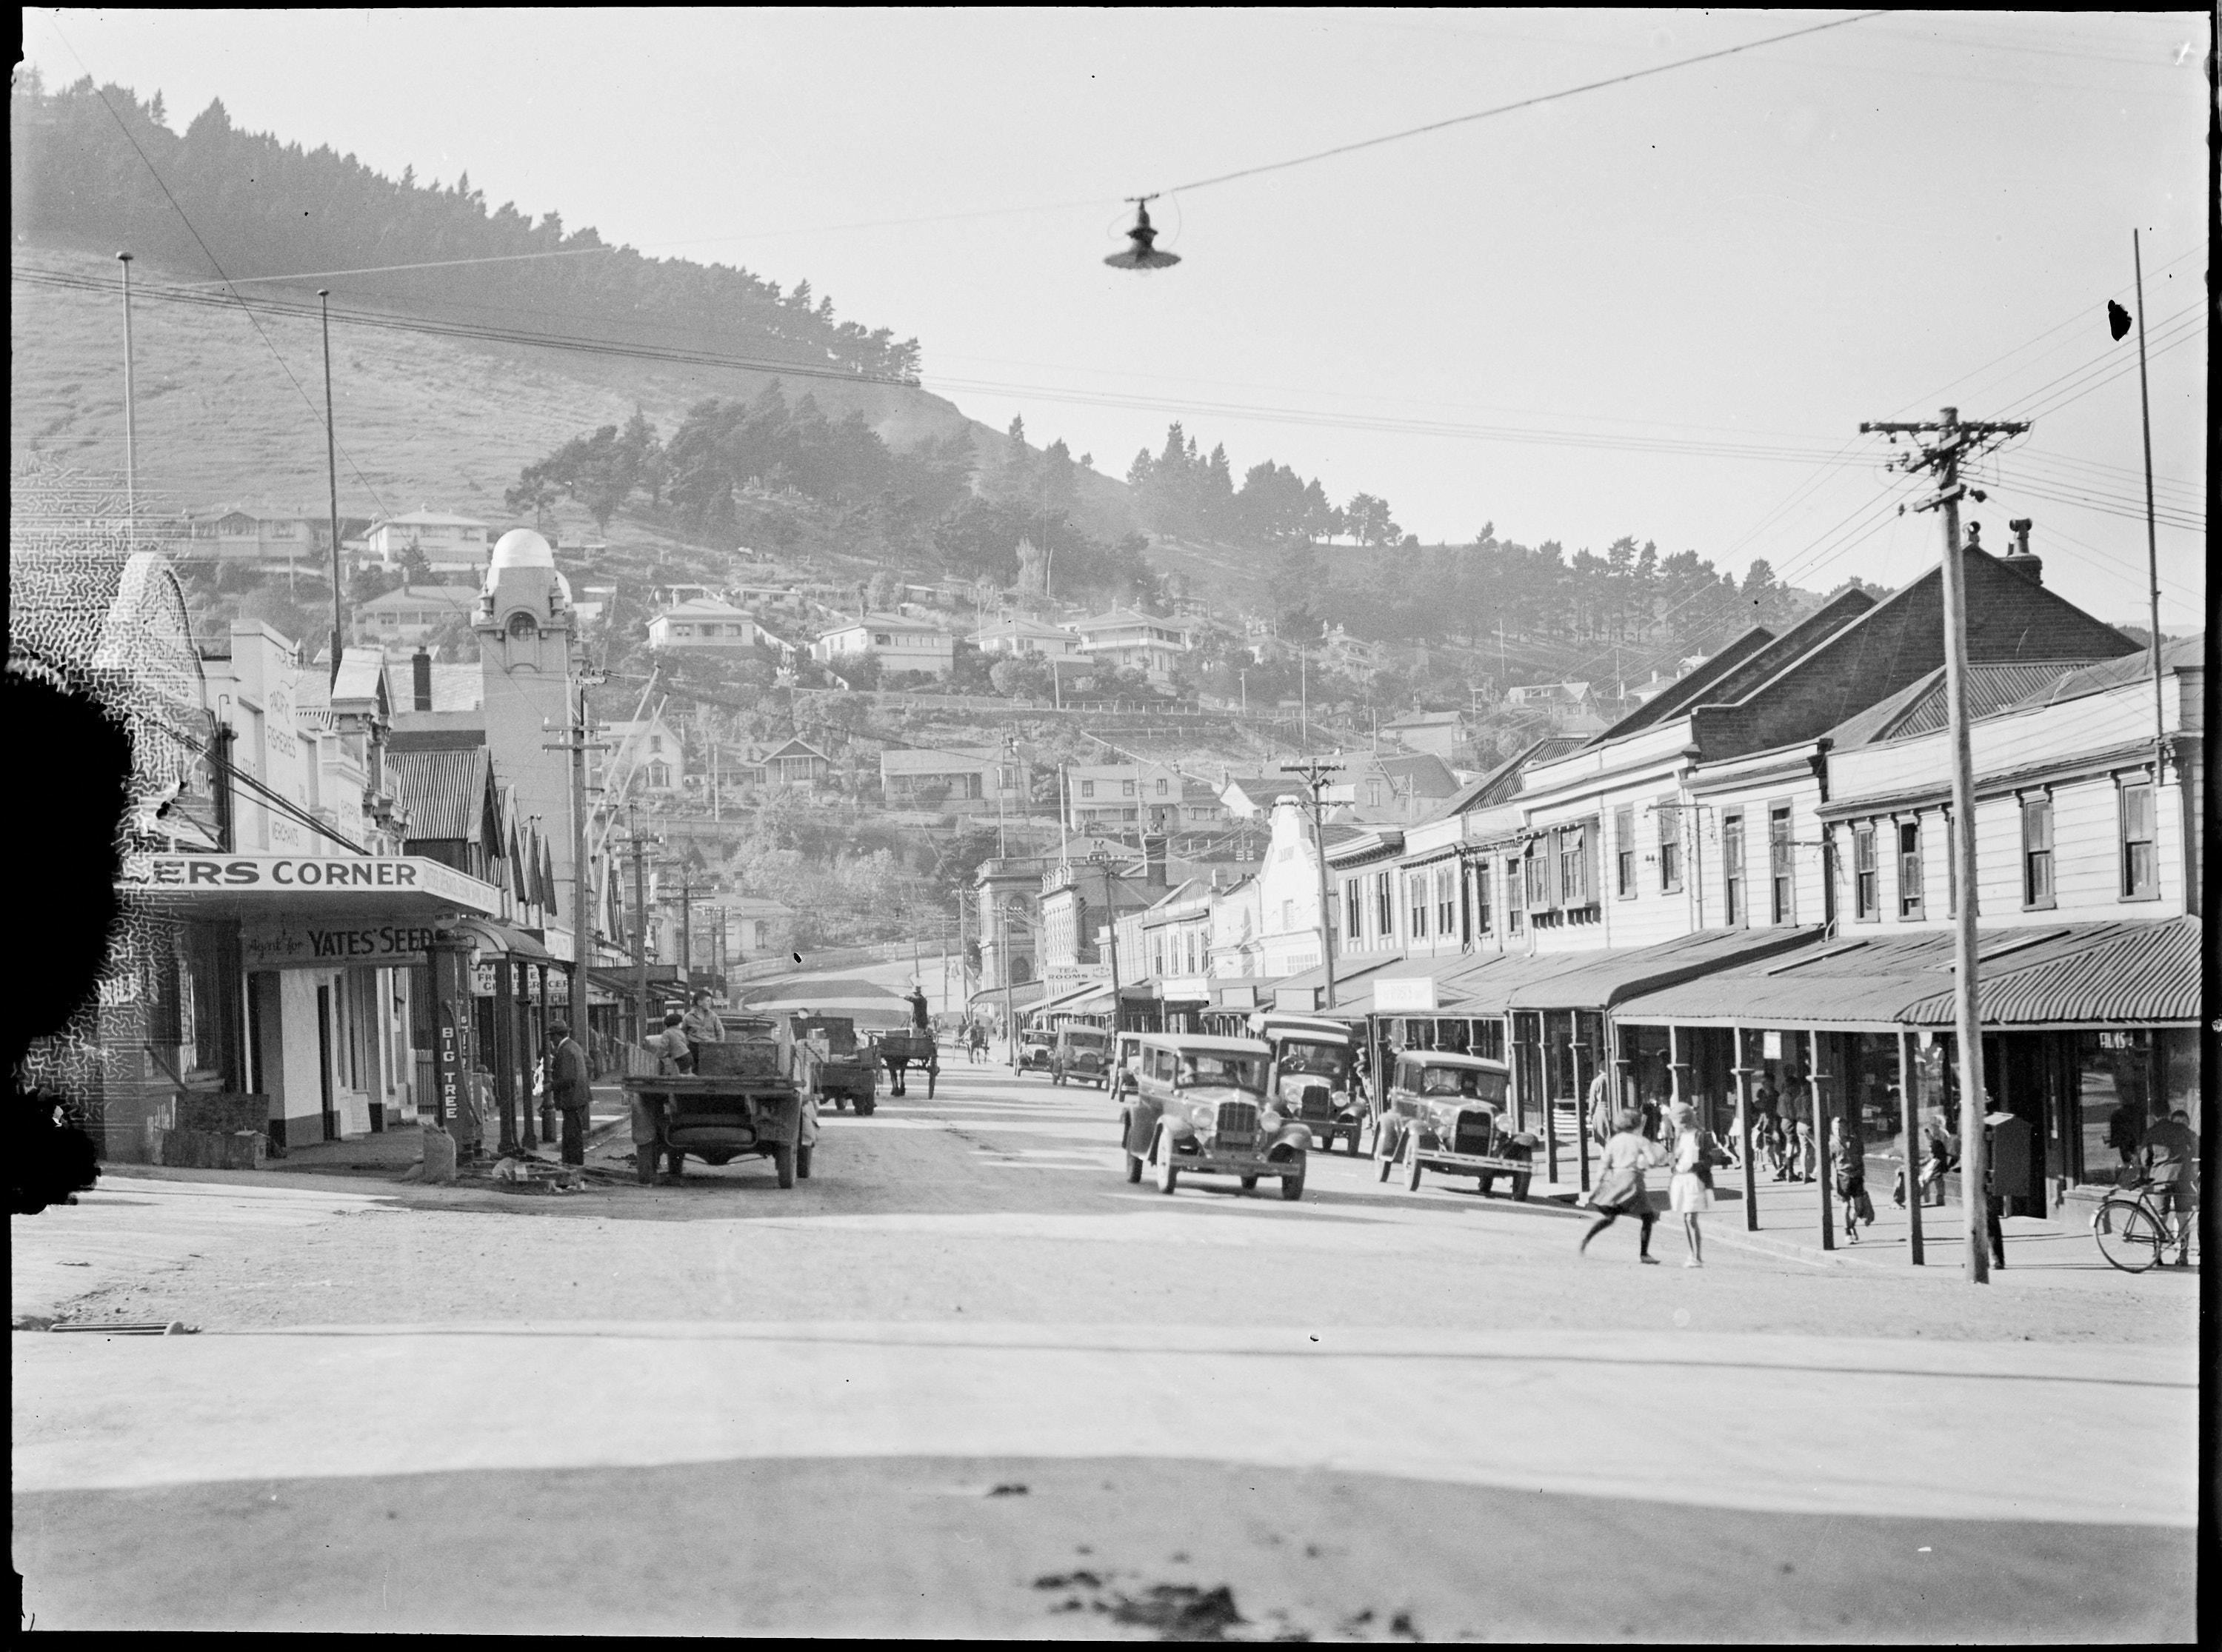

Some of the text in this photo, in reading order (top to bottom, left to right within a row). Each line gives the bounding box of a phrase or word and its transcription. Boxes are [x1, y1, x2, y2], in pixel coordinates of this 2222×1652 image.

[269, 689, 290, 725] PACIFIC
[267, 724, 296, 760] FISHERIES
[271, 820, 299, 847] MERCHANTS
[153, 860, 260, 885] ERS
[271, 860, 417, 886] CORNER
[442, 1027, 457, 1119] BIG TREE
